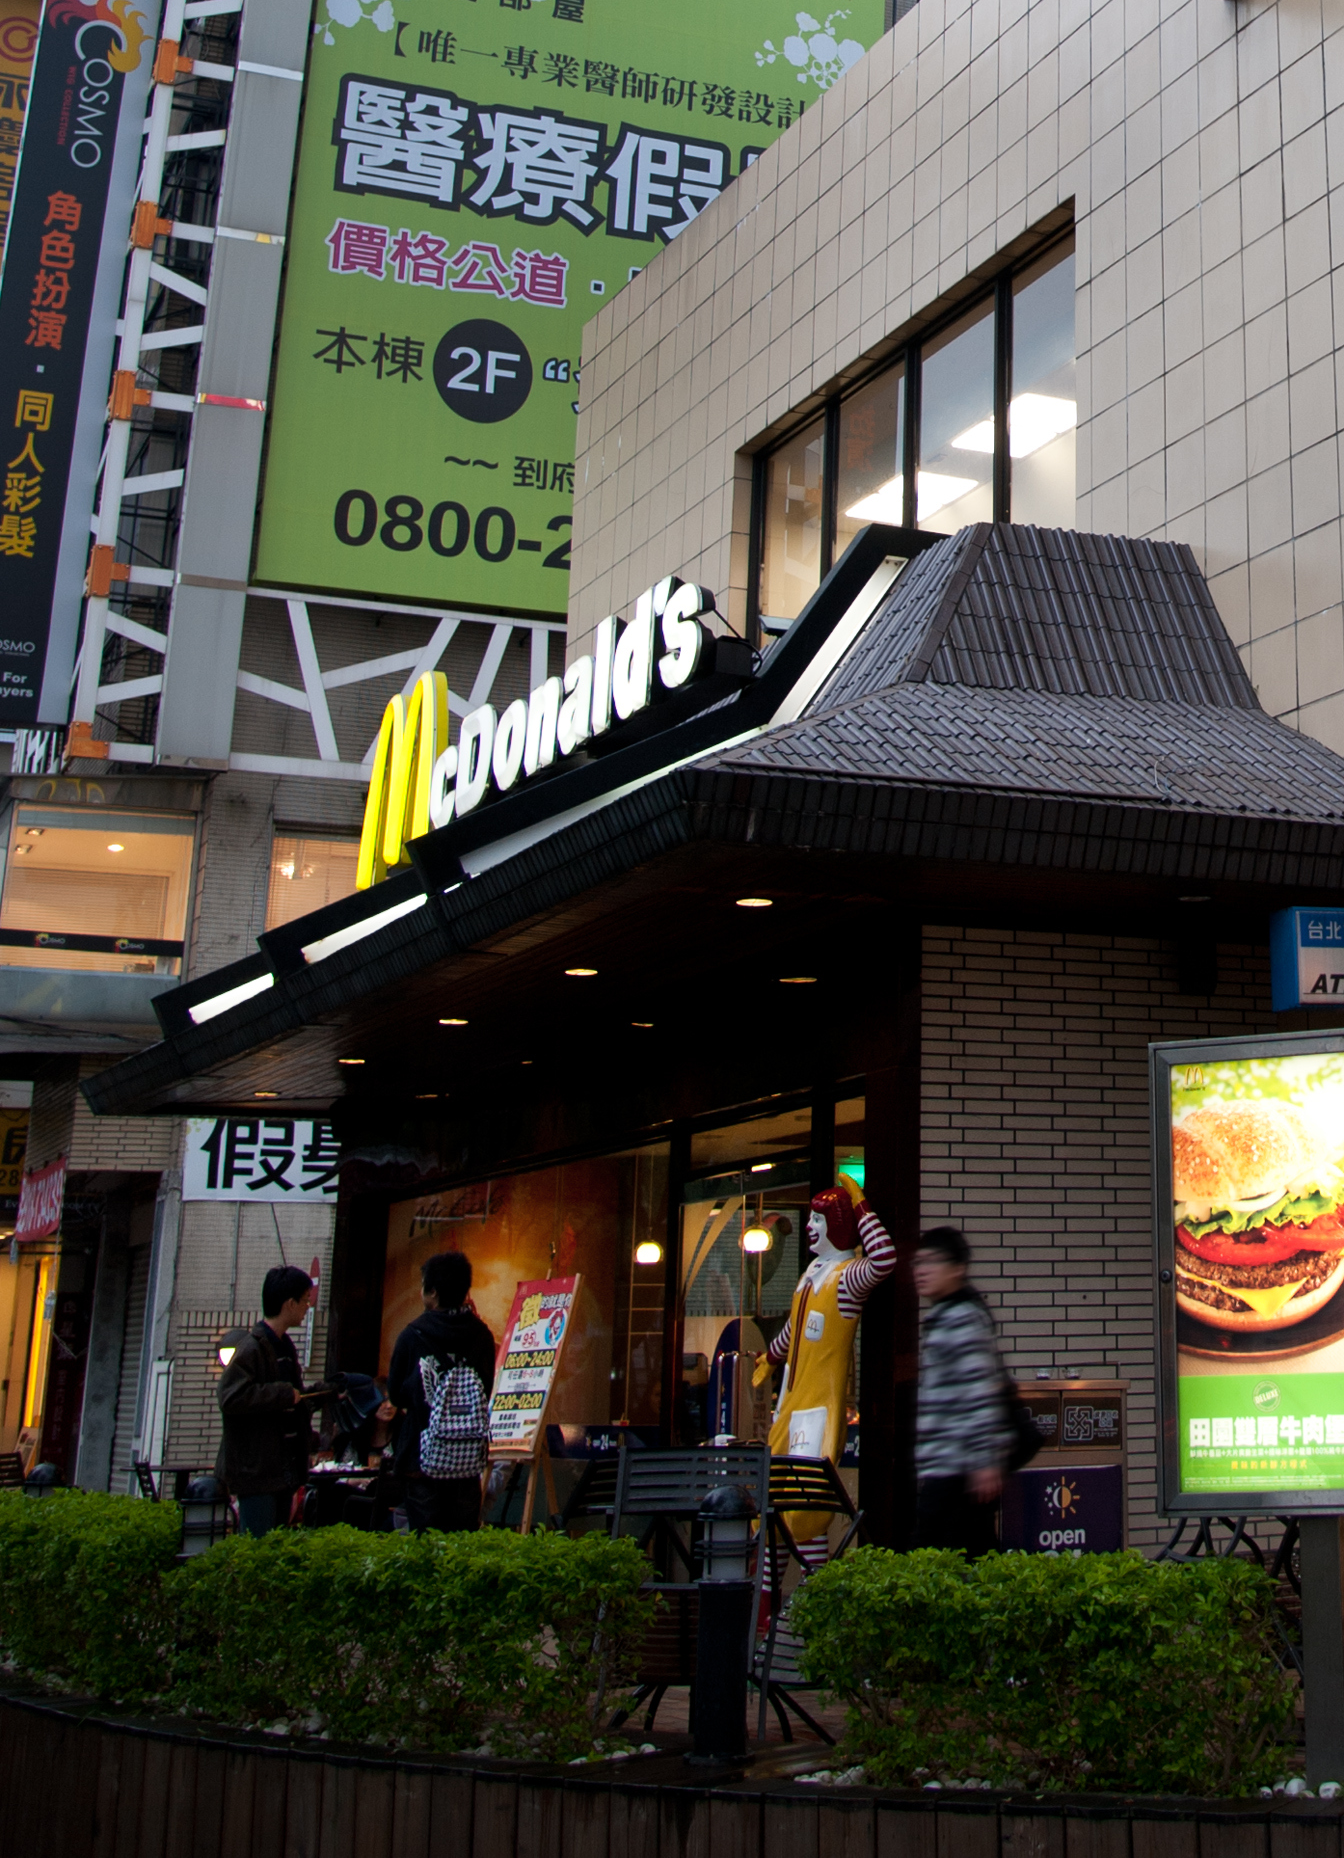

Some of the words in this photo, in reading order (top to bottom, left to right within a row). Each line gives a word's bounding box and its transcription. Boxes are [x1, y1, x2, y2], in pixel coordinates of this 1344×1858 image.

[71, 19, 128, 169] COSMO
[312, 325, 426, 385] 本棟
[445, 345, 523, 395] 2F
[3, 671, 28, 684] For
[356, 575, 710, 890] McDonald's
[1038, 1528, 1086, 1549] open
